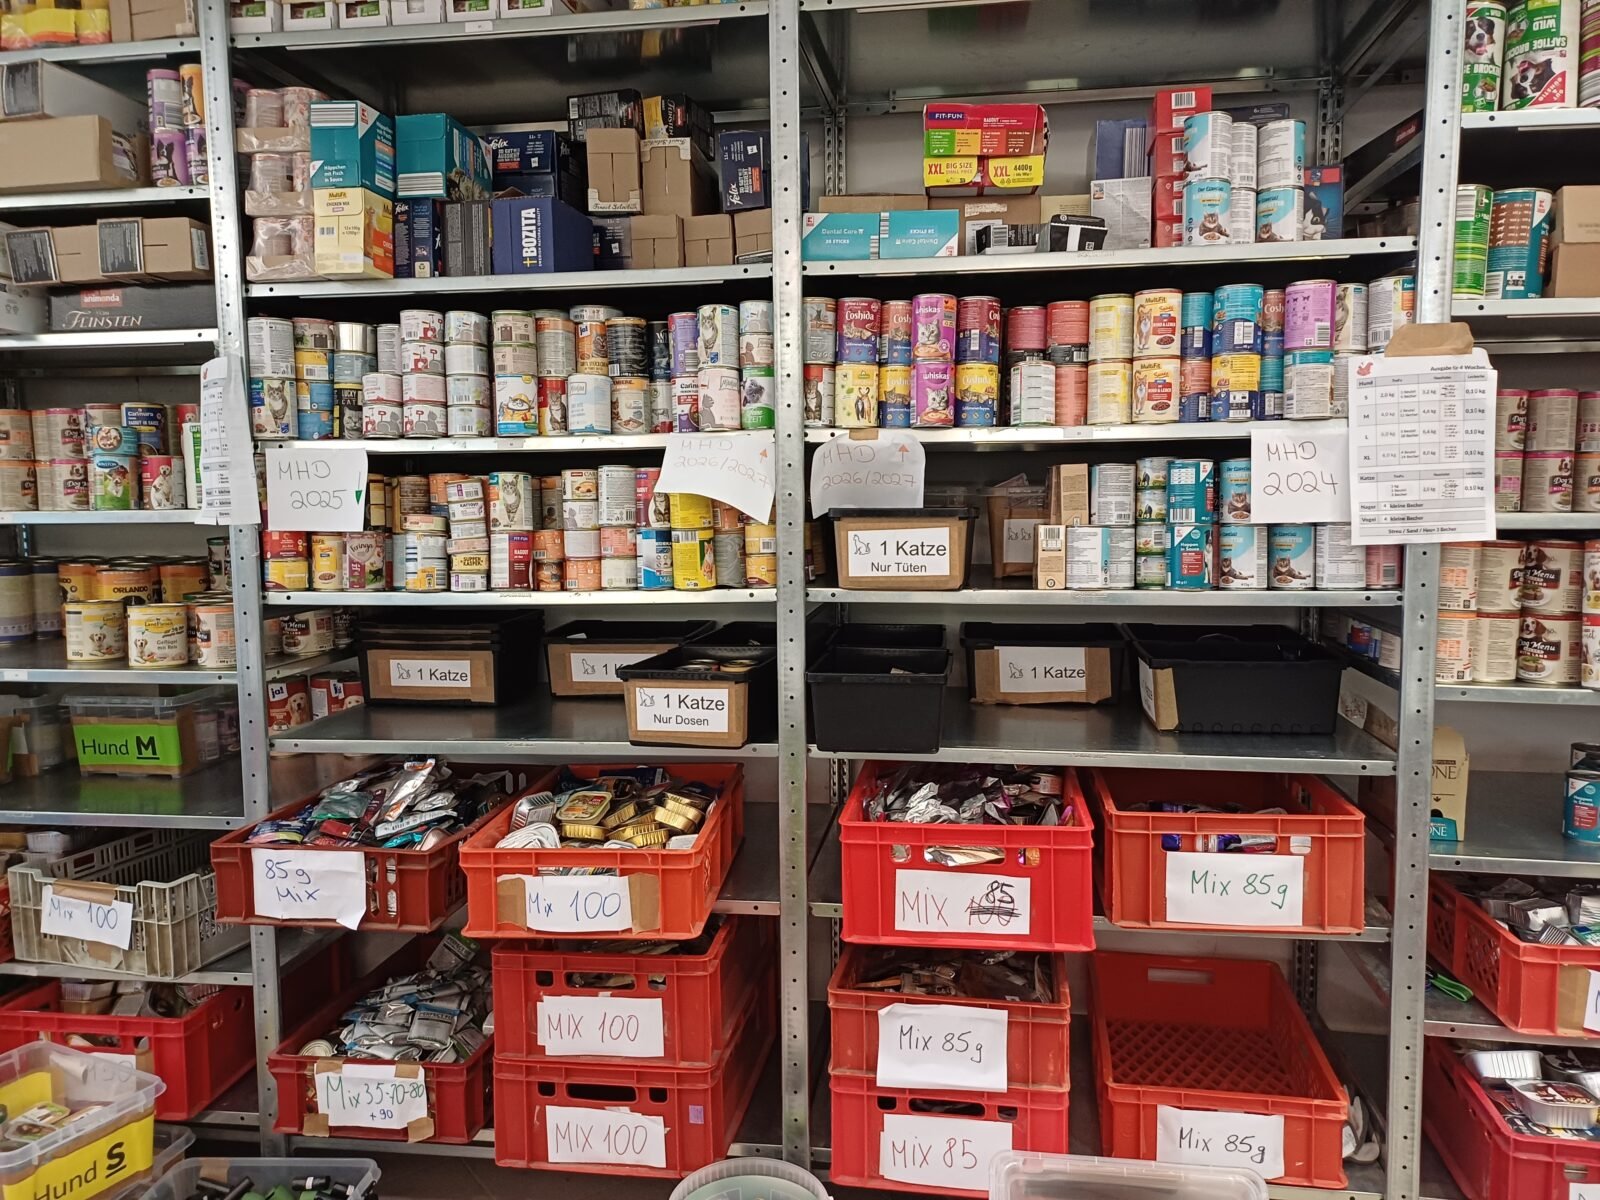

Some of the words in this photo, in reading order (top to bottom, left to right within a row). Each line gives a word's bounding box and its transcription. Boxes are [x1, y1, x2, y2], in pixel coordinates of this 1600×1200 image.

[928, 163, 945, 175] XXL
[959, 161, 973, 169] SIZE
[993, 165, 1010, 177] XXL
[521, 207, 537, 257] BOZITA
[83, 293, 120, 302] animonda
[61, 310, 143, 329] FEINSTEN
[845, 311, 874, 321] Coshida
[915, 306, 941, 314] whiskas
[579, 326, 588, 335] ja!
[342, 388, 357, 398] LUCKY
[681, 439, 734, 452] MHD
[821, 444, 876, 466] MHD
[1267, 441, 1317, 462] MHD
[278, 460, 331, 481] MHD
[673, 455, 772, 490] 2026/2027
[821, 470, 917, 490] 2026/2027
[1262, 471, 1339, 496] 2024
[290, 489, 348, 511] 2025
[881, 541, 887, 556] 1
[896, 540, 947, 557] Katze
[871, 562, 891, 573] Nur
[894, 562, 927, 573] Tüten
[1532, 569, 1556, 579] Menu
[112, 586, 148, 594] ORLANDO
[1532, 641, 1556, 651] Menu
[417, 669, 423, 681] 1
[429, 668, 469, 682] Katze
[1031, 666, 1037, 679] 1
[1044, 666, 1086, 679] Katze
[270, 686, 284, 699] ja!
[664, 694, 670, 708] 1
[678, 694, 725, 711] Katze
[653, 714, 672, 725] Nur
[675, 715, 709, 726] Dosen
[81, 739, 129, 756] Hund
[136, 735, 158, 757] M
[276, 886, 320, 903] Mix
[1190, 870, 1231, 897] Mix
[1242, 873, 1289, 910] 85g
[48, 897, 74, 921] Mix
[86, 900, 119, 930] 100
[528, 892, 553, 918] Mix
[569, 890, 622, 922] 100
[547, 1013, 584, 1040] MIX
[598, 1012, 640, 1043] 100
[898, 1024, 933, 1051] Mix
[325, 1075, 361, 1110] Mix
[554, 1121, 595, 1154] MIX
[602, 1124, 648, 1156] 100
[1178, 1126, 1213, 1152] Mix
[105, 1141, 128, 1172] S
[942, 1137, 978, 1170] 85
